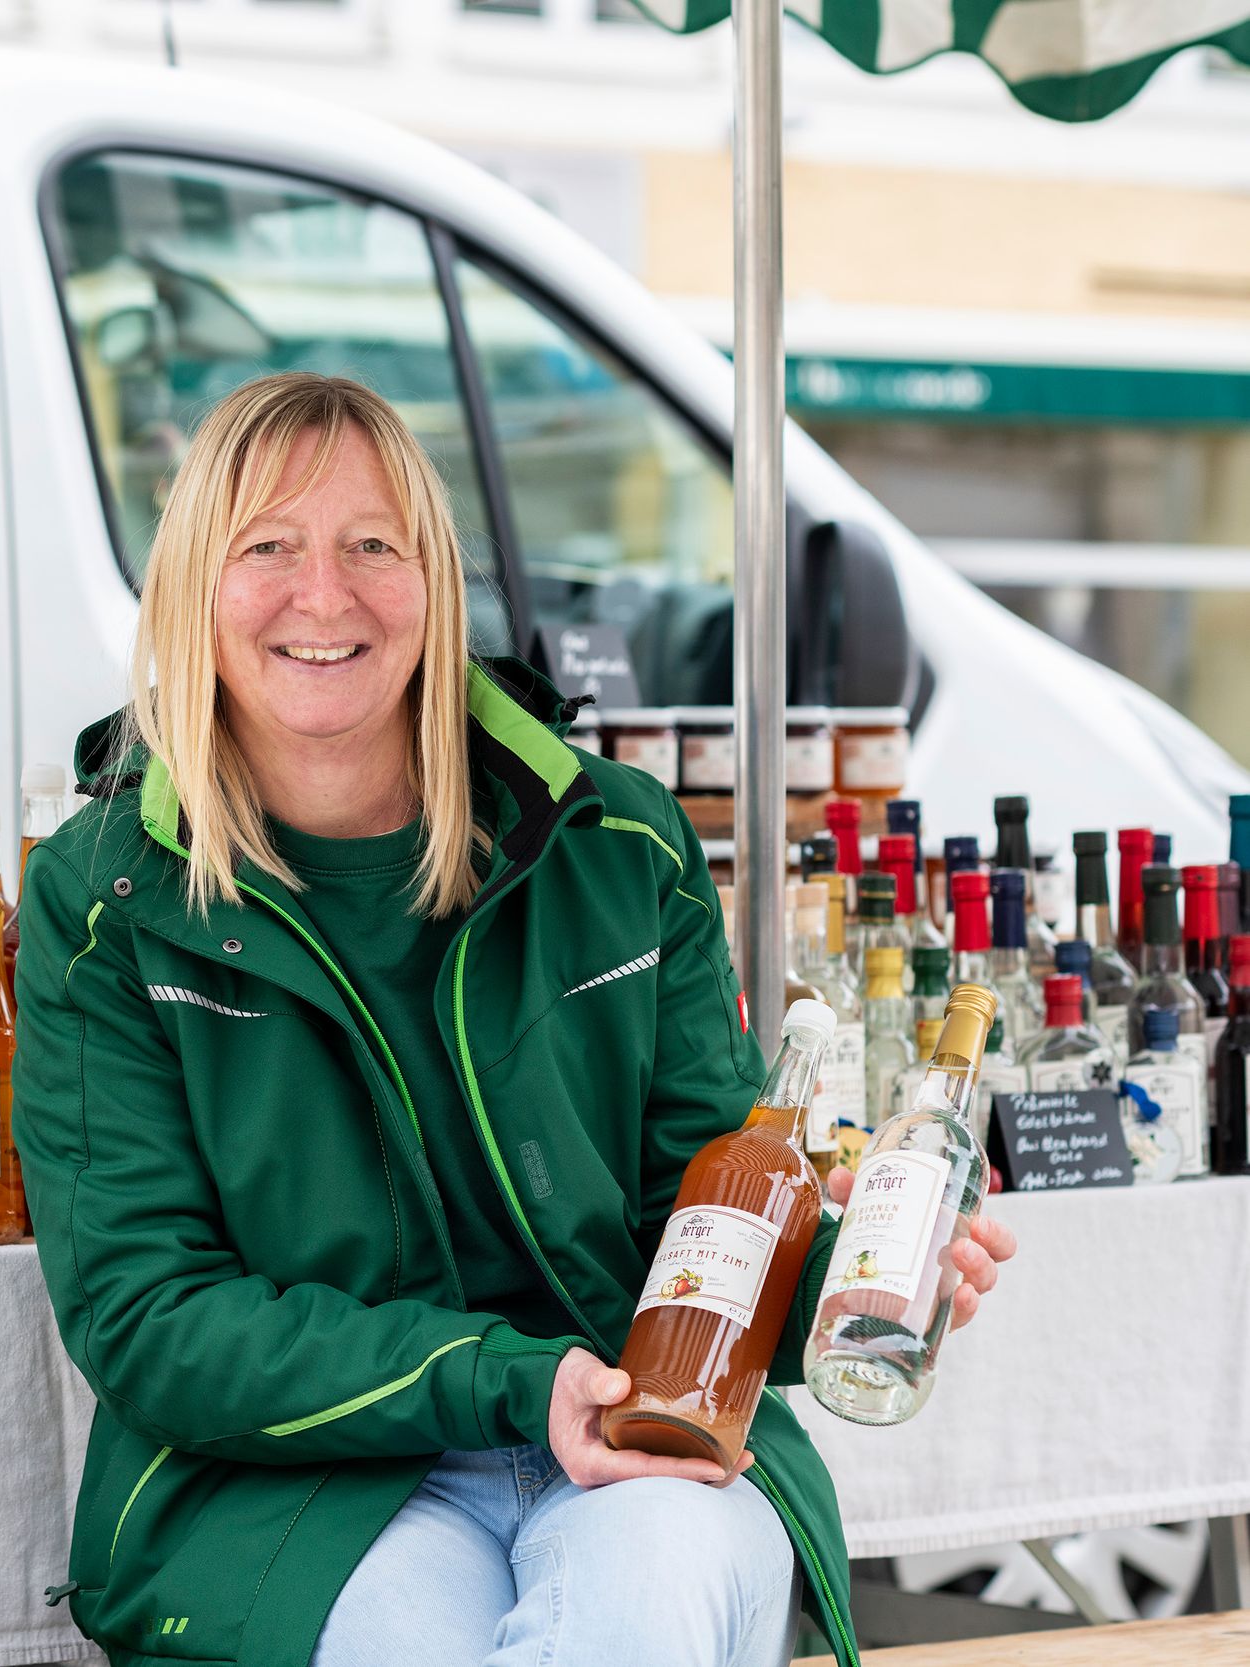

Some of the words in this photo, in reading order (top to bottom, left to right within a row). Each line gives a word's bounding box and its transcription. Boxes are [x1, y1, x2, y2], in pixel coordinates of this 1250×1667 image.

[865, 1176, 906, 1193] berger
[858, 1204, 899, 1215] BIRNEN
[857, 1213, 894, 1224] BRAND
[680, 1224, 713, 1238] berger
[697, 1250, 718, 1260] MIT
[722, 1254, 750, 1271] ZIMT
